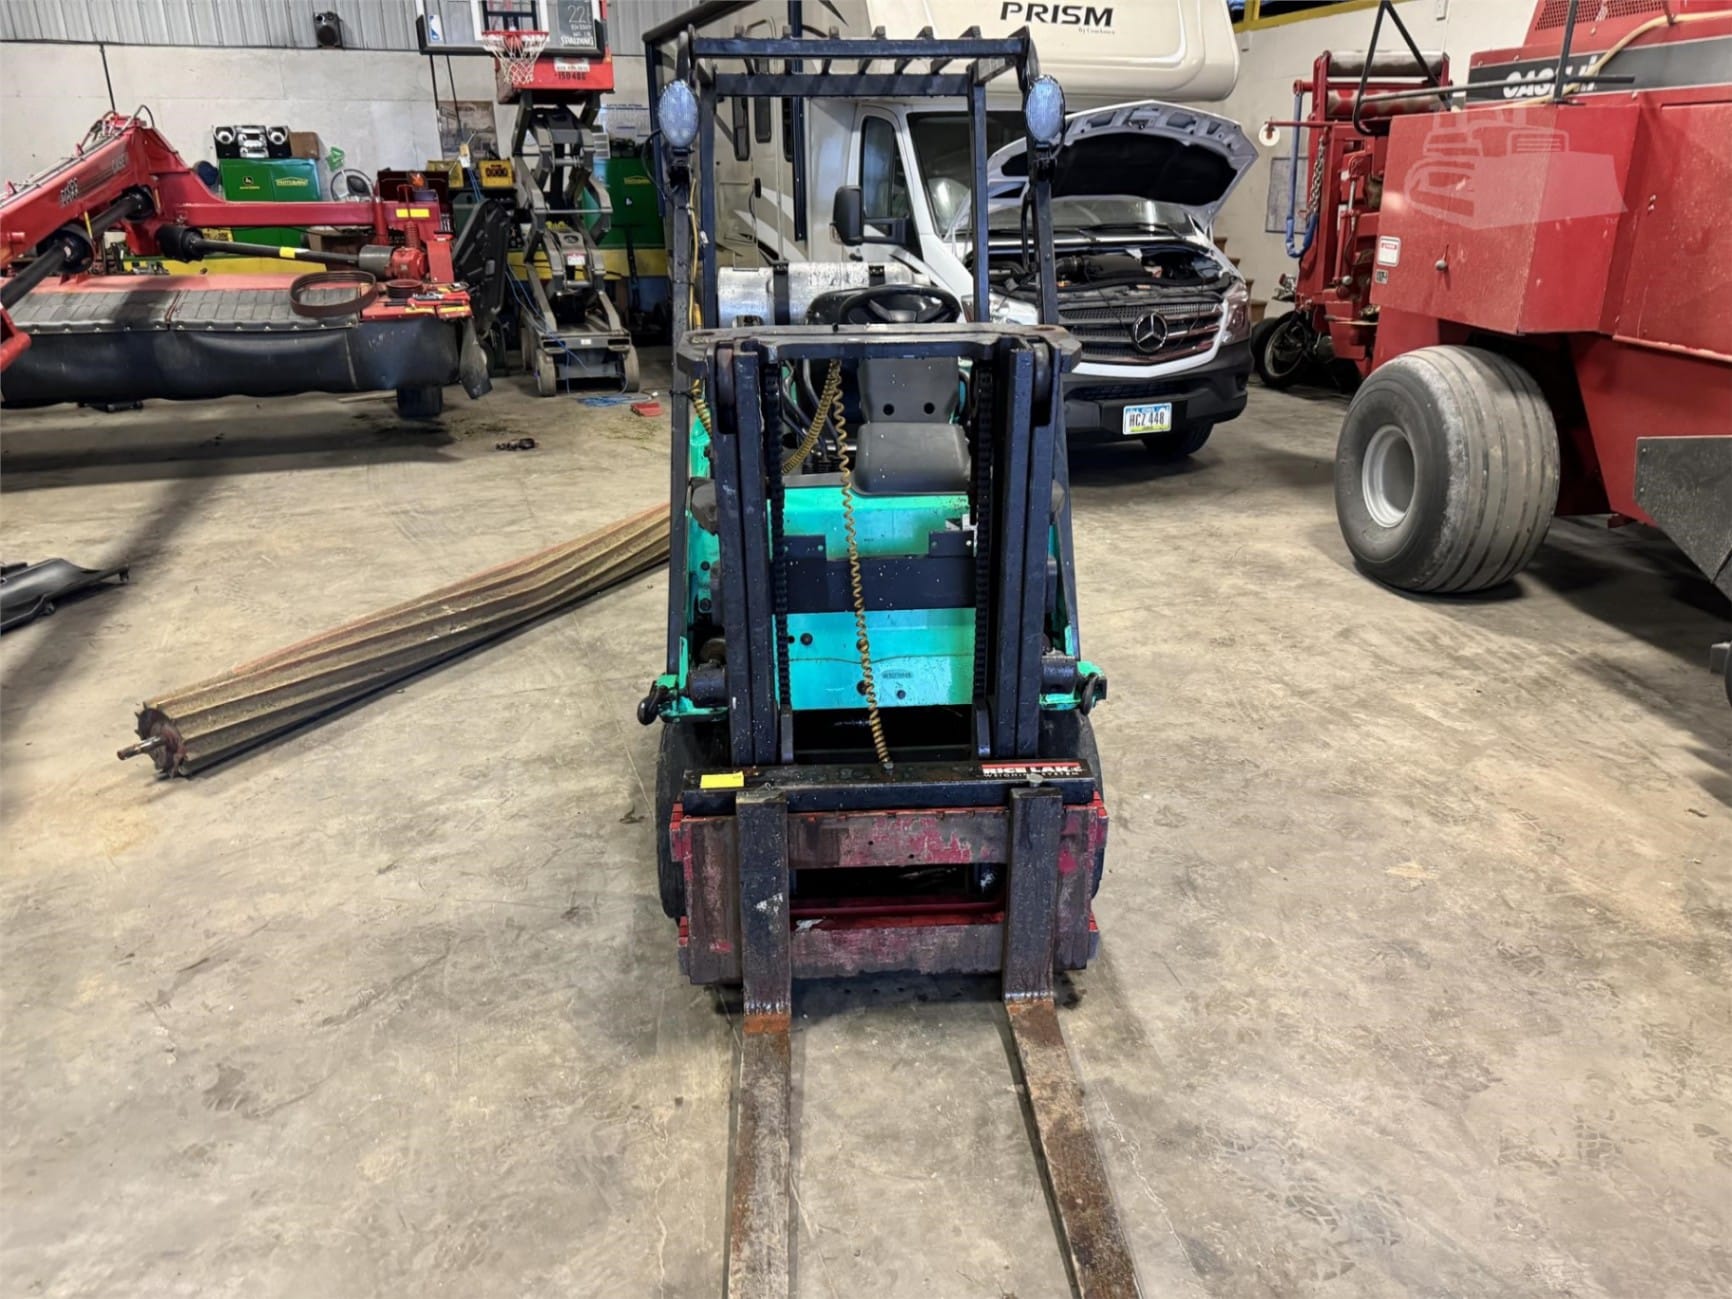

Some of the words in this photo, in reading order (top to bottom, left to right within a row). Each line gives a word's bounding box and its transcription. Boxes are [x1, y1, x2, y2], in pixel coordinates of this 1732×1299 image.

[1000, 2, 1113, 27] PRISM
[1129, 413, 1146, 427] HCZ
[1148, 411, 1165, 426] 448
[983, 766, 1027, 775] RICE
